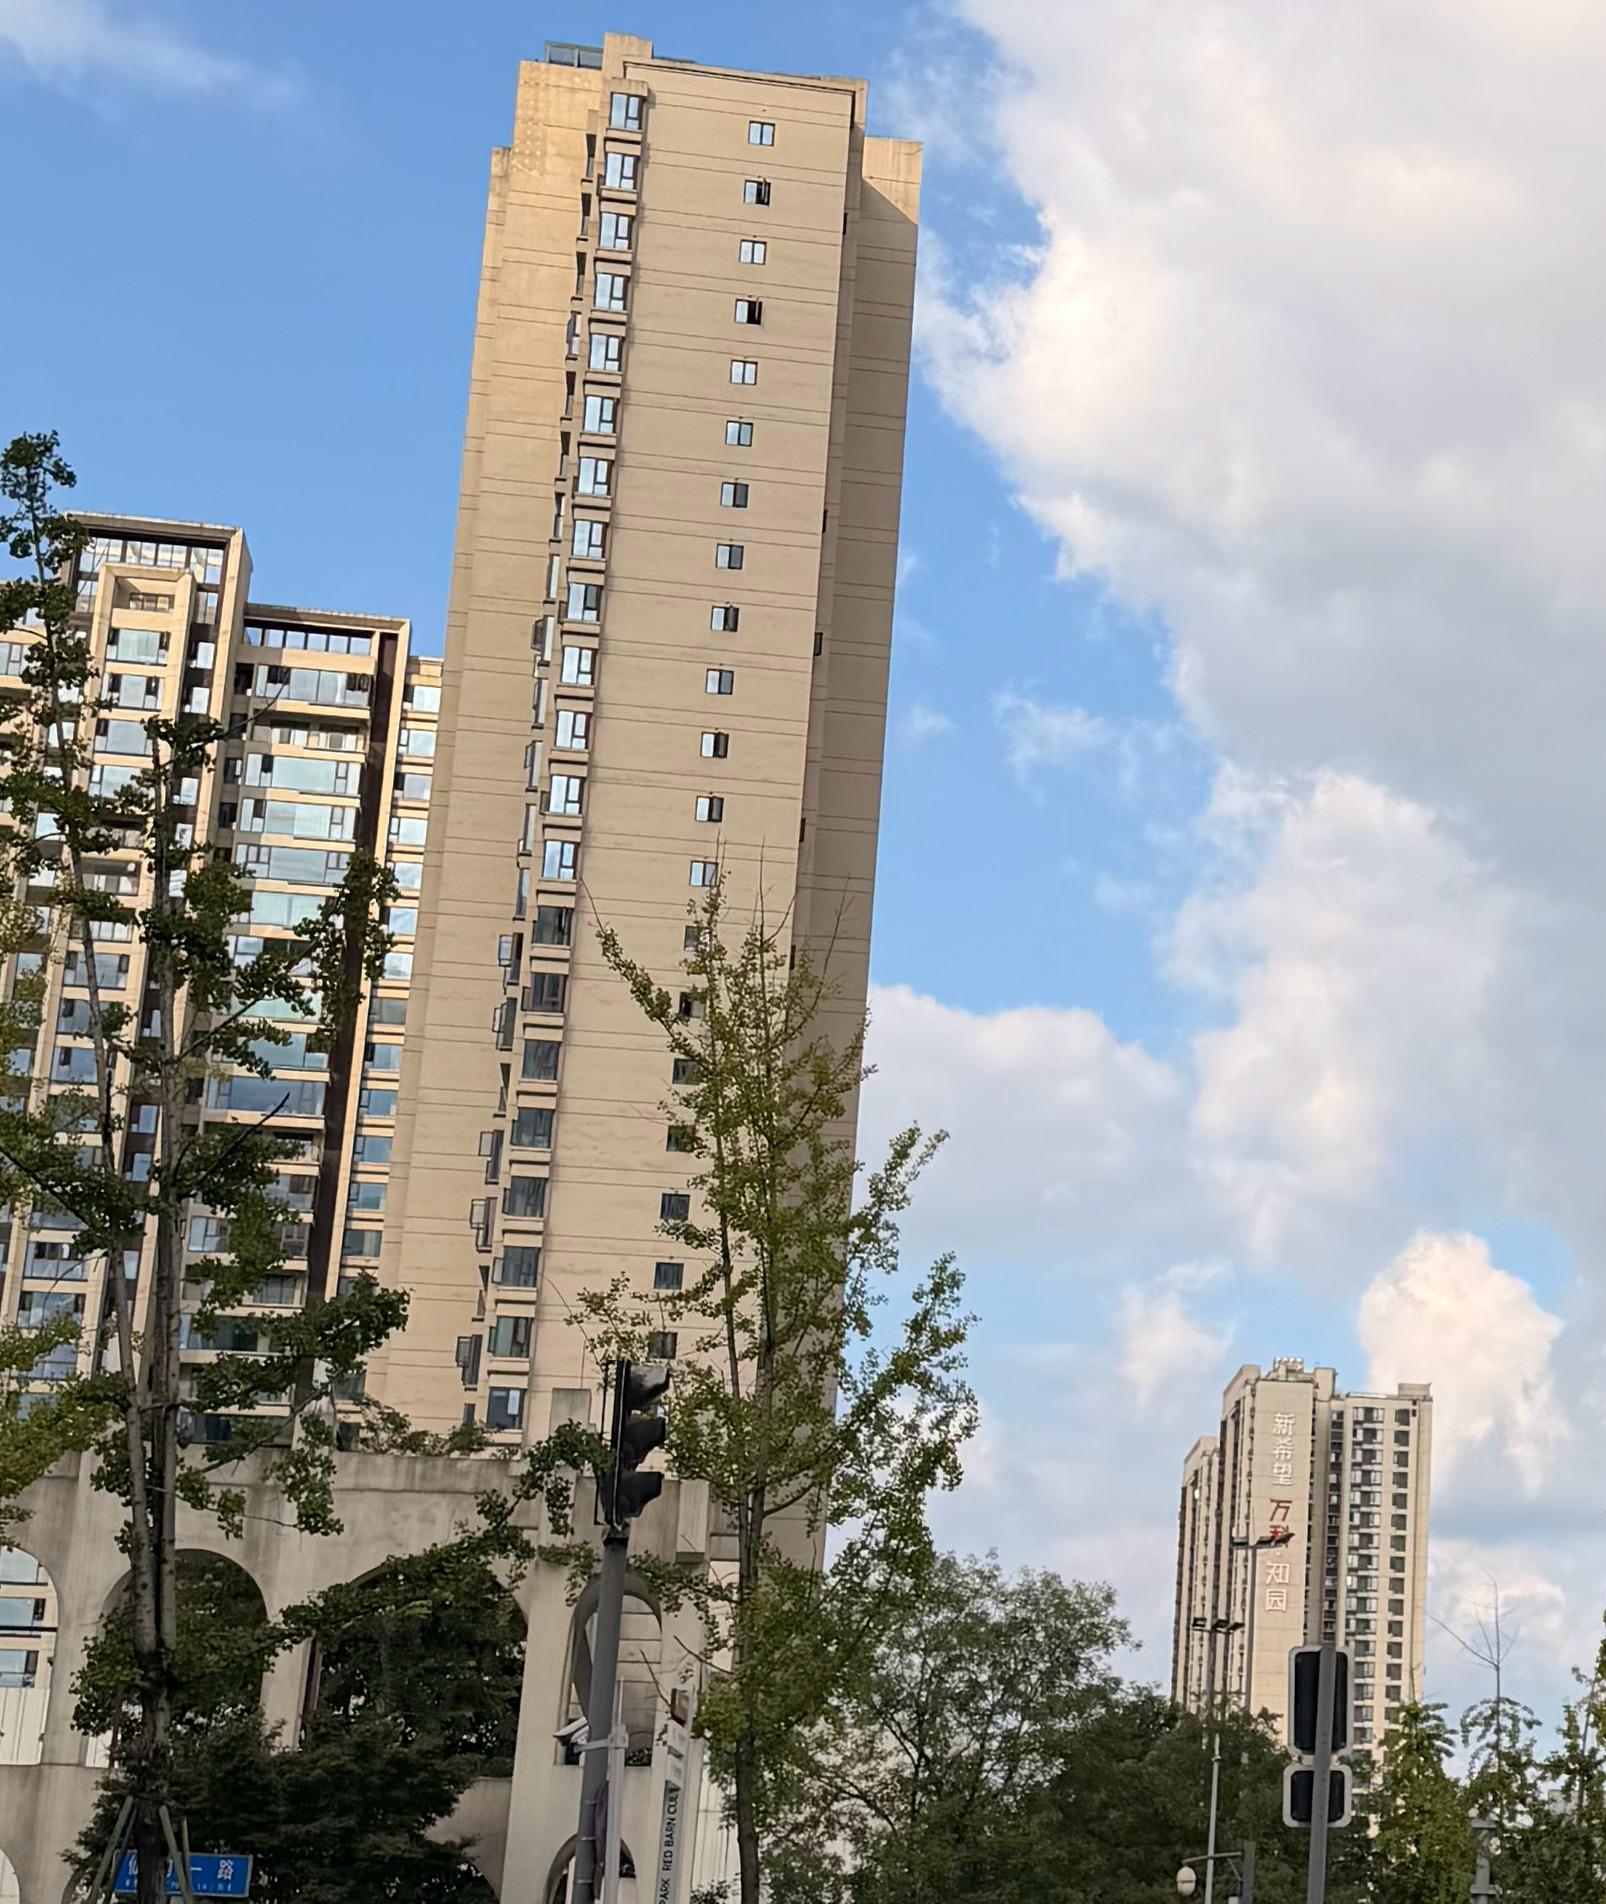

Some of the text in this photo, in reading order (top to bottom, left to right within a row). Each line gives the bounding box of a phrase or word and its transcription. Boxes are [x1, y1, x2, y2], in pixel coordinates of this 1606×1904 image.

[1272, 1412, 1295, 1486] 新希望
[664, 1817, 676, 1847] BARN
[662, 1850, 673, 1871] RED
